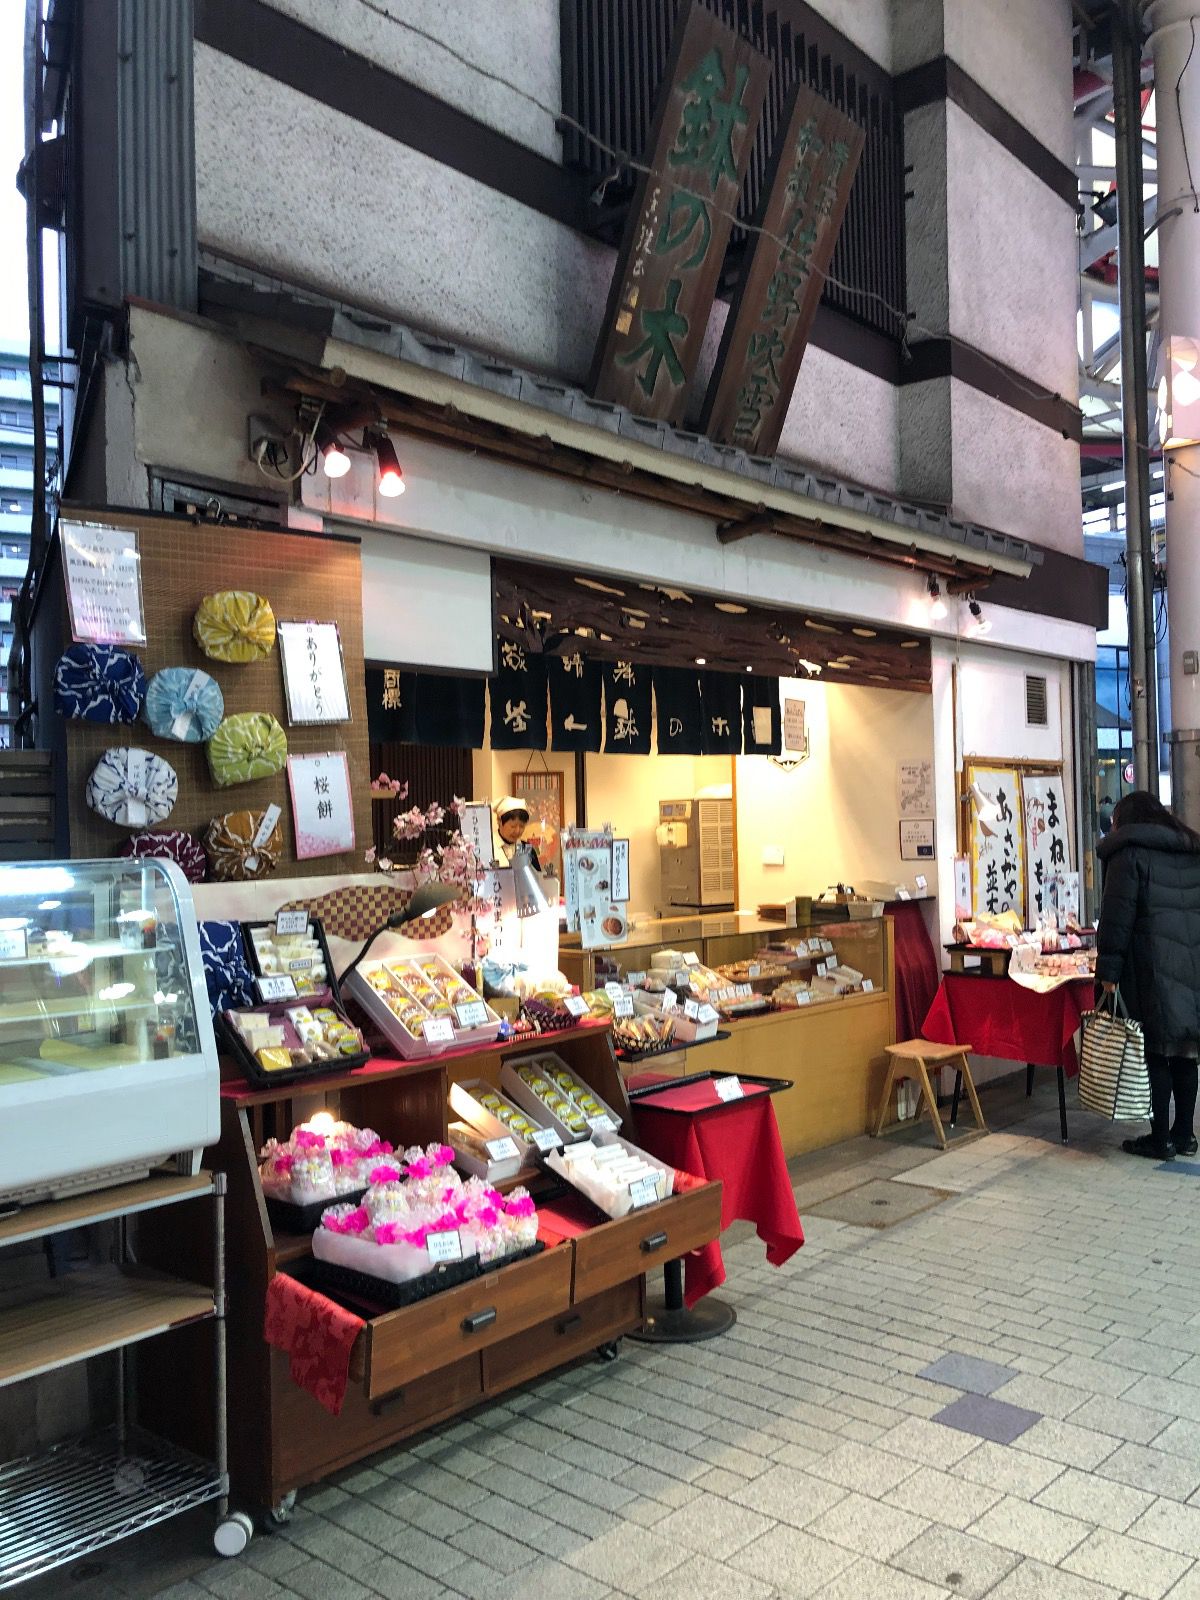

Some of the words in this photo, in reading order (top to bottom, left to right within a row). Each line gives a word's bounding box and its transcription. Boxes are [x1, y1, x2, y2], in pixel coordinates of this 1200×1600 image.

[304, 635, 324, 717] ありがとう
[313, 775, 334, 820] 桜餅
[493, 881, 504, 948] ひなまつり
